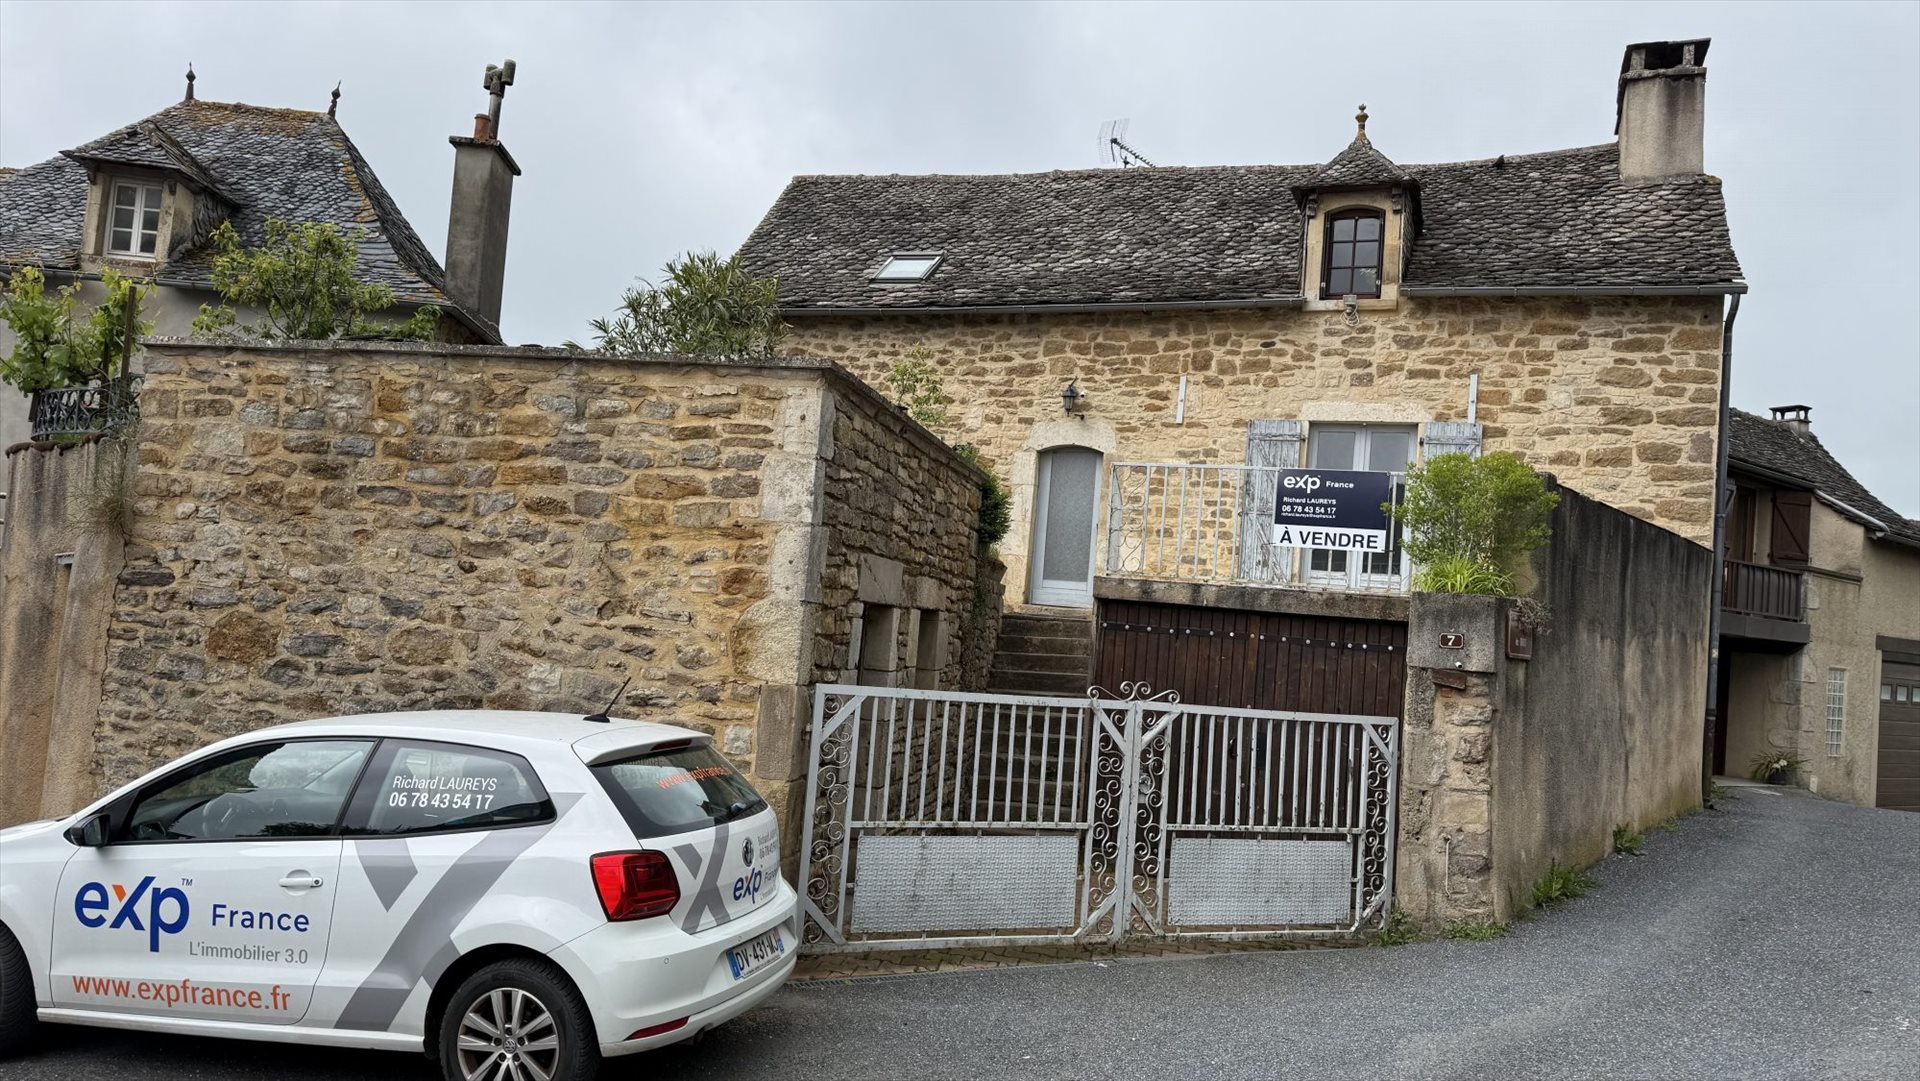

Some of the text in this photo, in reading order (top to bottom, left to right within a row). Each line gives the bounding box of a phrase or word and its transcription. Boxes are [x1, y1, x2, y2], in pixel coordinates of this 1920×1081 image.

[1283, 474, 1354, 494] exp France
[1283, 496, 1337, 505] Richard LAUREYS
[1293, 505, 1302, 513] 78
[1315, 506, 1325, 514] 54
[1279, 526, 1378, 549] À VENDRE
[1447, 635, 1456, 646] 7
[392, 775, 498, 791] Richard LAUREYS
[389, 791, 494, 810] 06 78 43 54 17
[733, 867, 762, 905] exp
[74, 875, 190, 953] exp
[211, 903, 310, 933] France
[189, 941, 308, 964] L'immobilier 3.0
[72, 975, 291, 1011] www.expfrance.fr
